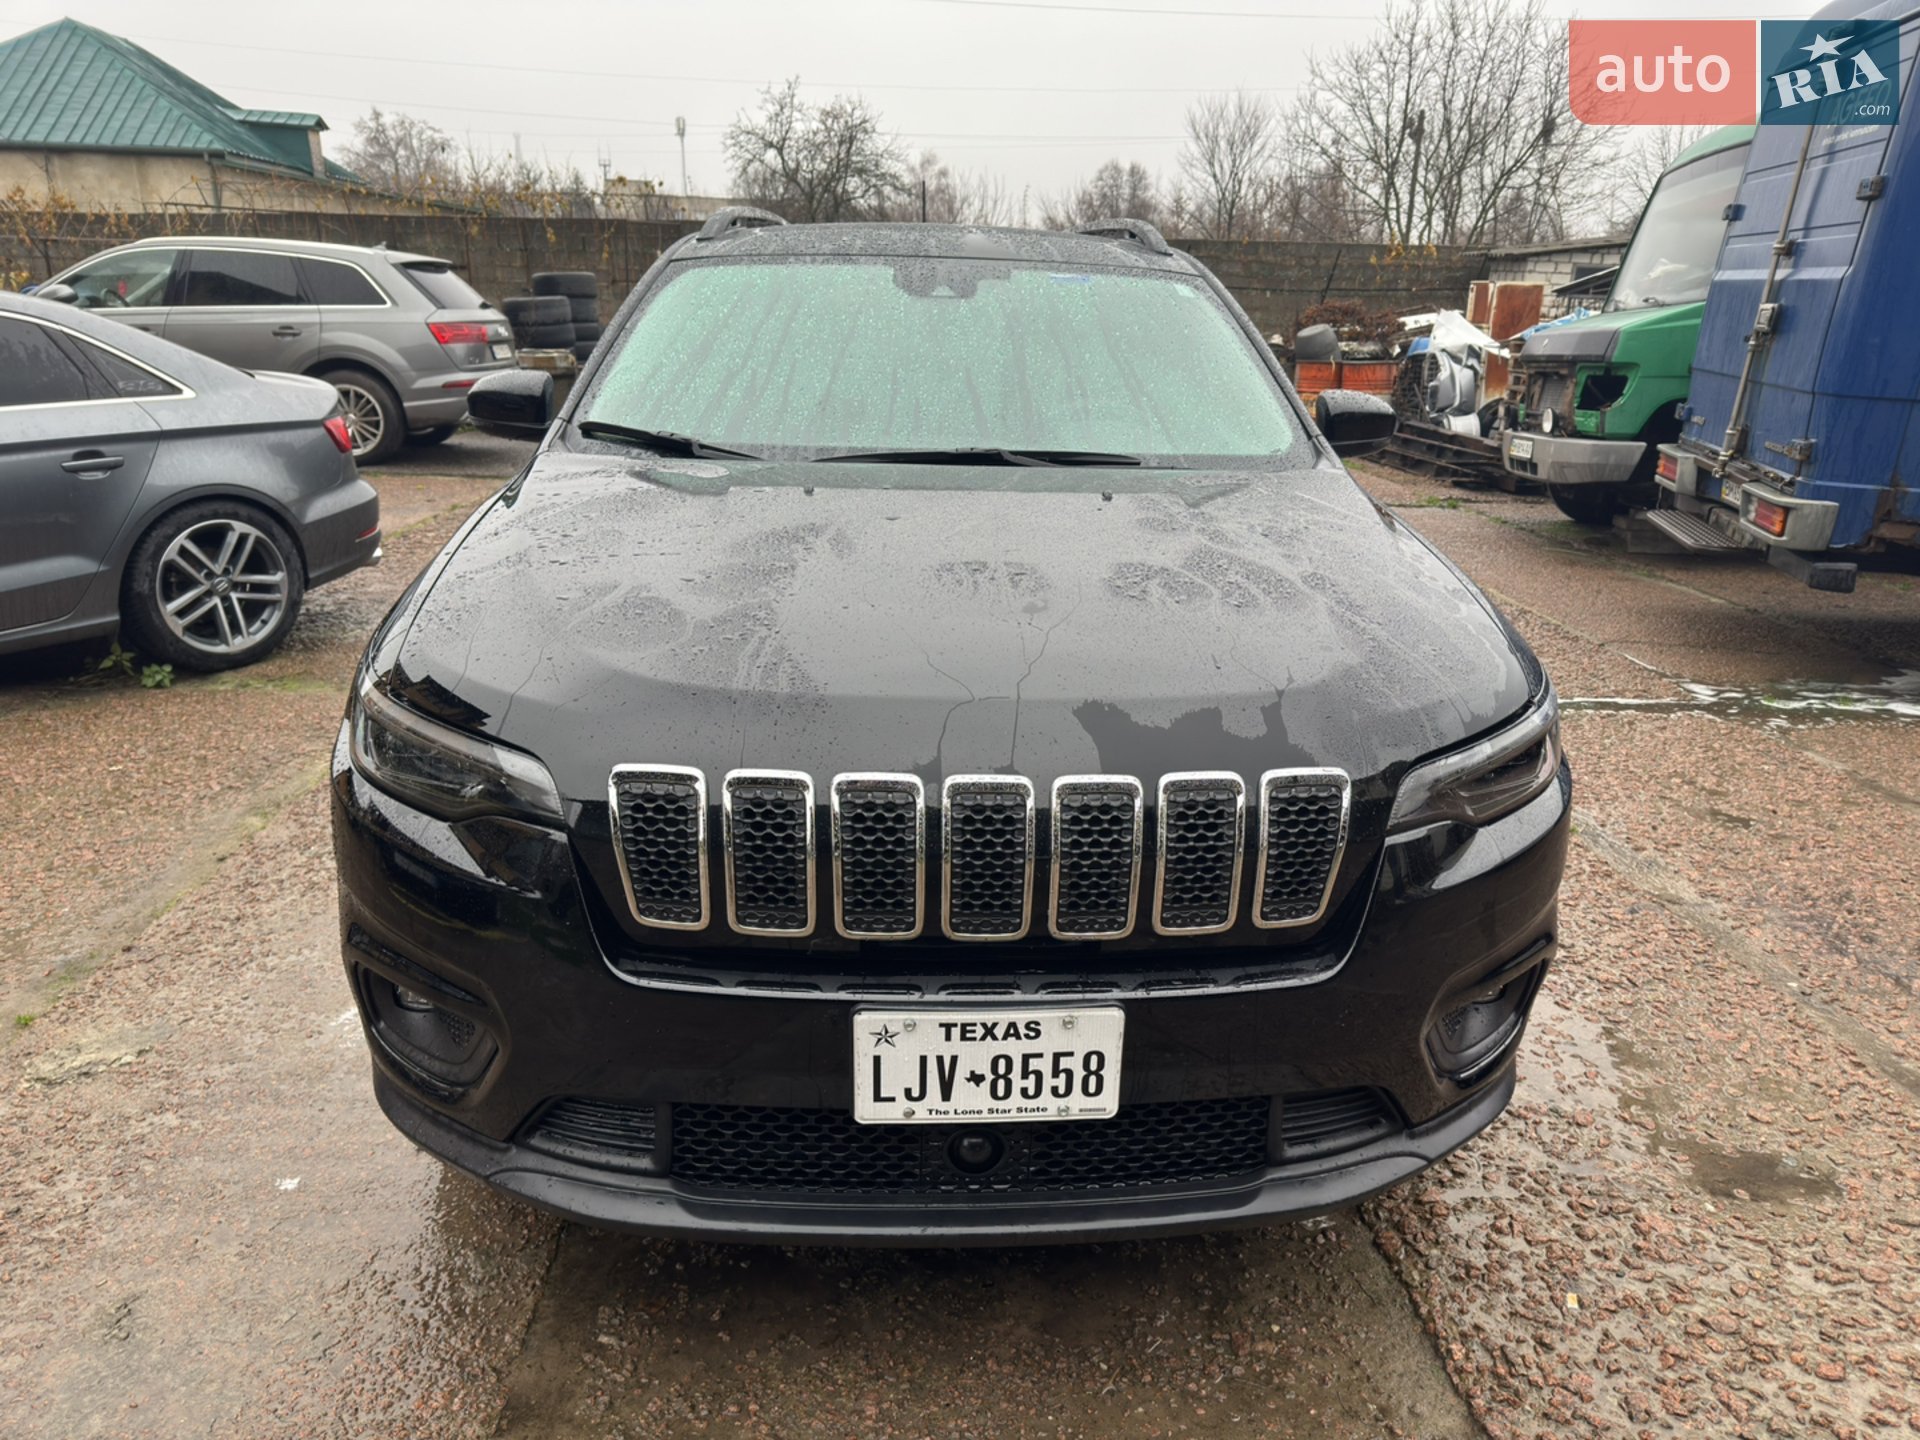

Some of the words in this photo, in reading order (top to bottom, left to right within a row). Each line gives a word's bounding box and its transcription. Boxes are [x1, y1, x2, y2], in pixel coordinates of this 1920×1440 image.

[938, 1020, 1042, 1042] TEXAS
[927, 1108, 950, 1116] The
[953, 1108, 984, 1116] Lone
[987, 1107, 1012, 1115] Star
[1016, 1106, 1048, 1114] State
